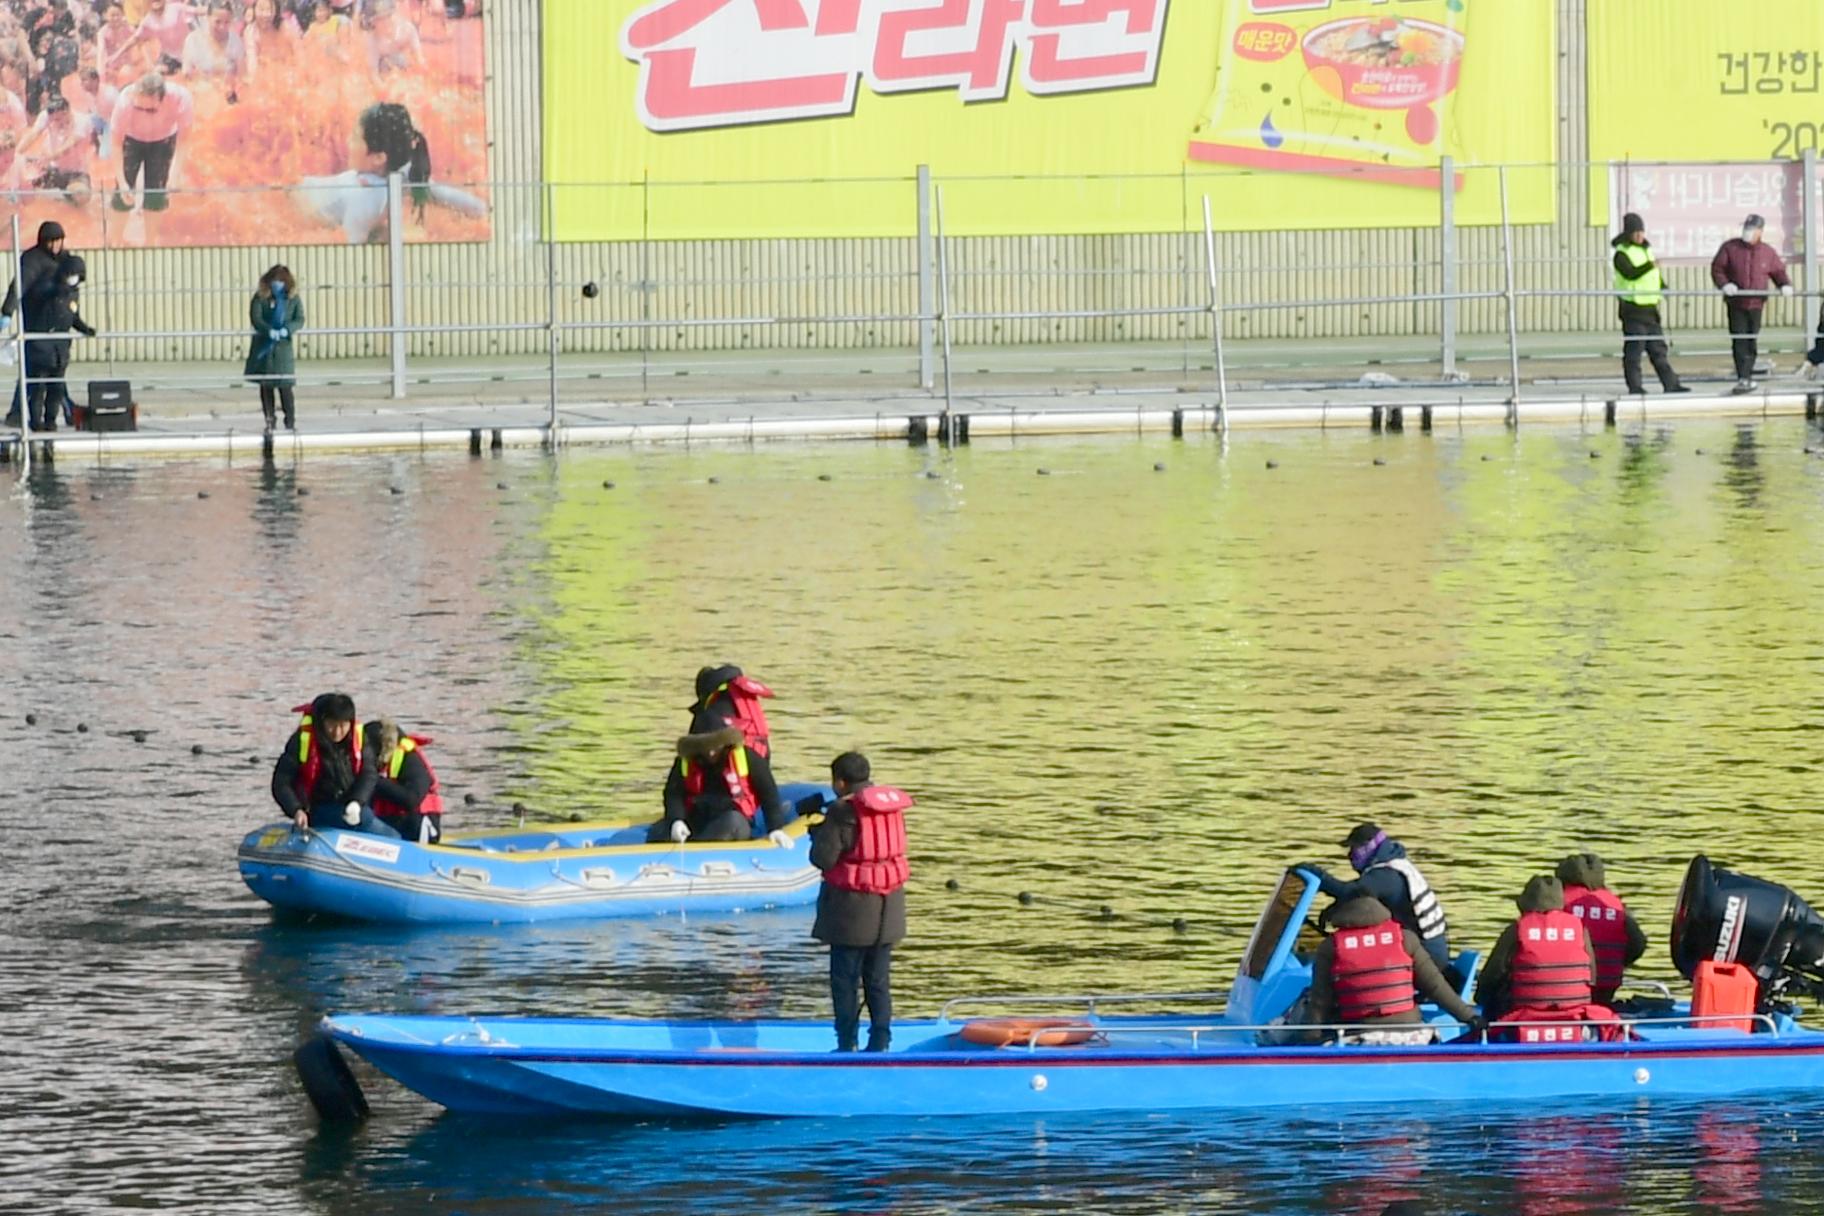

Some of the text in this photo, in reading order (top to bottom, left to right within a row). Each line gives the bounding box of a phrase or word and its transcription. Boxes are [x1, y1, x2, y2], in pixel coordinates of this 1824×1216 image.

[1237, 29, 1293, 53] 매운맛
[1717, 50, 1822, 94] 건강한
[1343, 931, 1394, 950] 화천군
[1528, 927, 1576, 942] 화천군
[1712, 895, 1741, 963] SUZUKI
